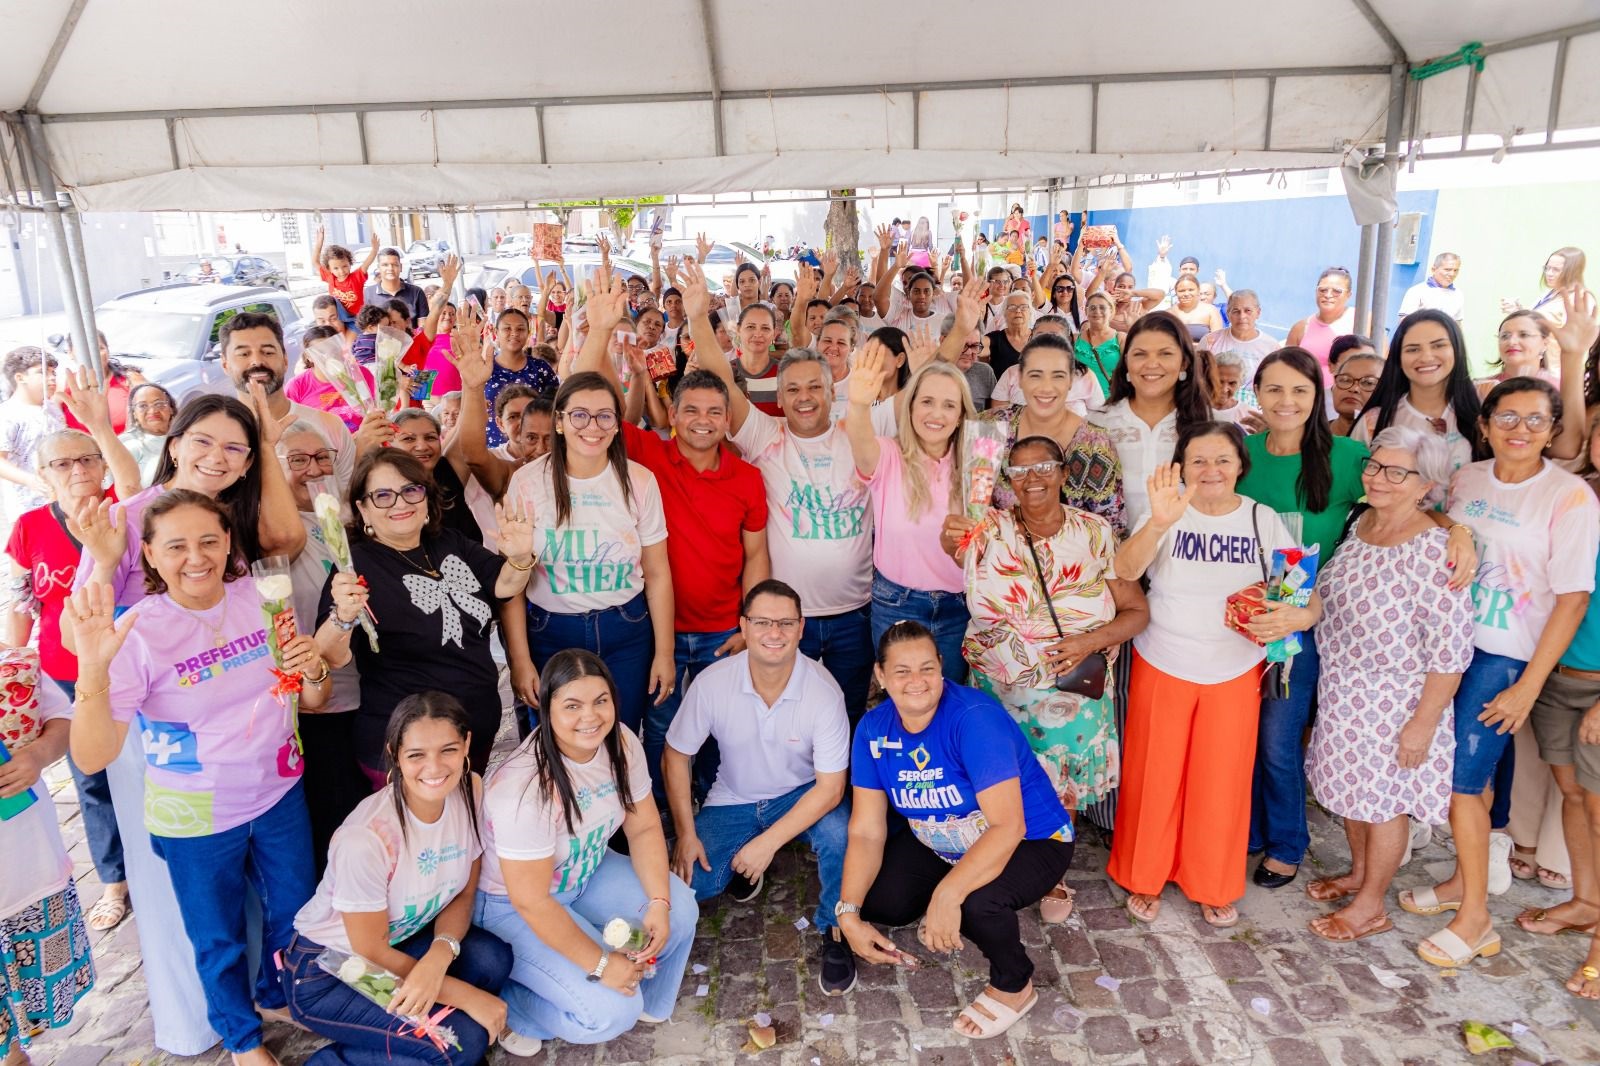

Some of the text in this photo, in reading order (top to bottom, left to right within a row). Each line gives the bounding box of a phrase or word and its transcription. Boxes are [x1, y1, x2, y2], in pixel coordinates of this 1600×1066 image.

[792, 506, 865, 540] LHER
[543, 528, 600, 562] MU
[1172, 530, 1256, 564] MON CHERI
[544, 563, 634, 595] LHER
[892, 785, 963, 808] LAGARTO
